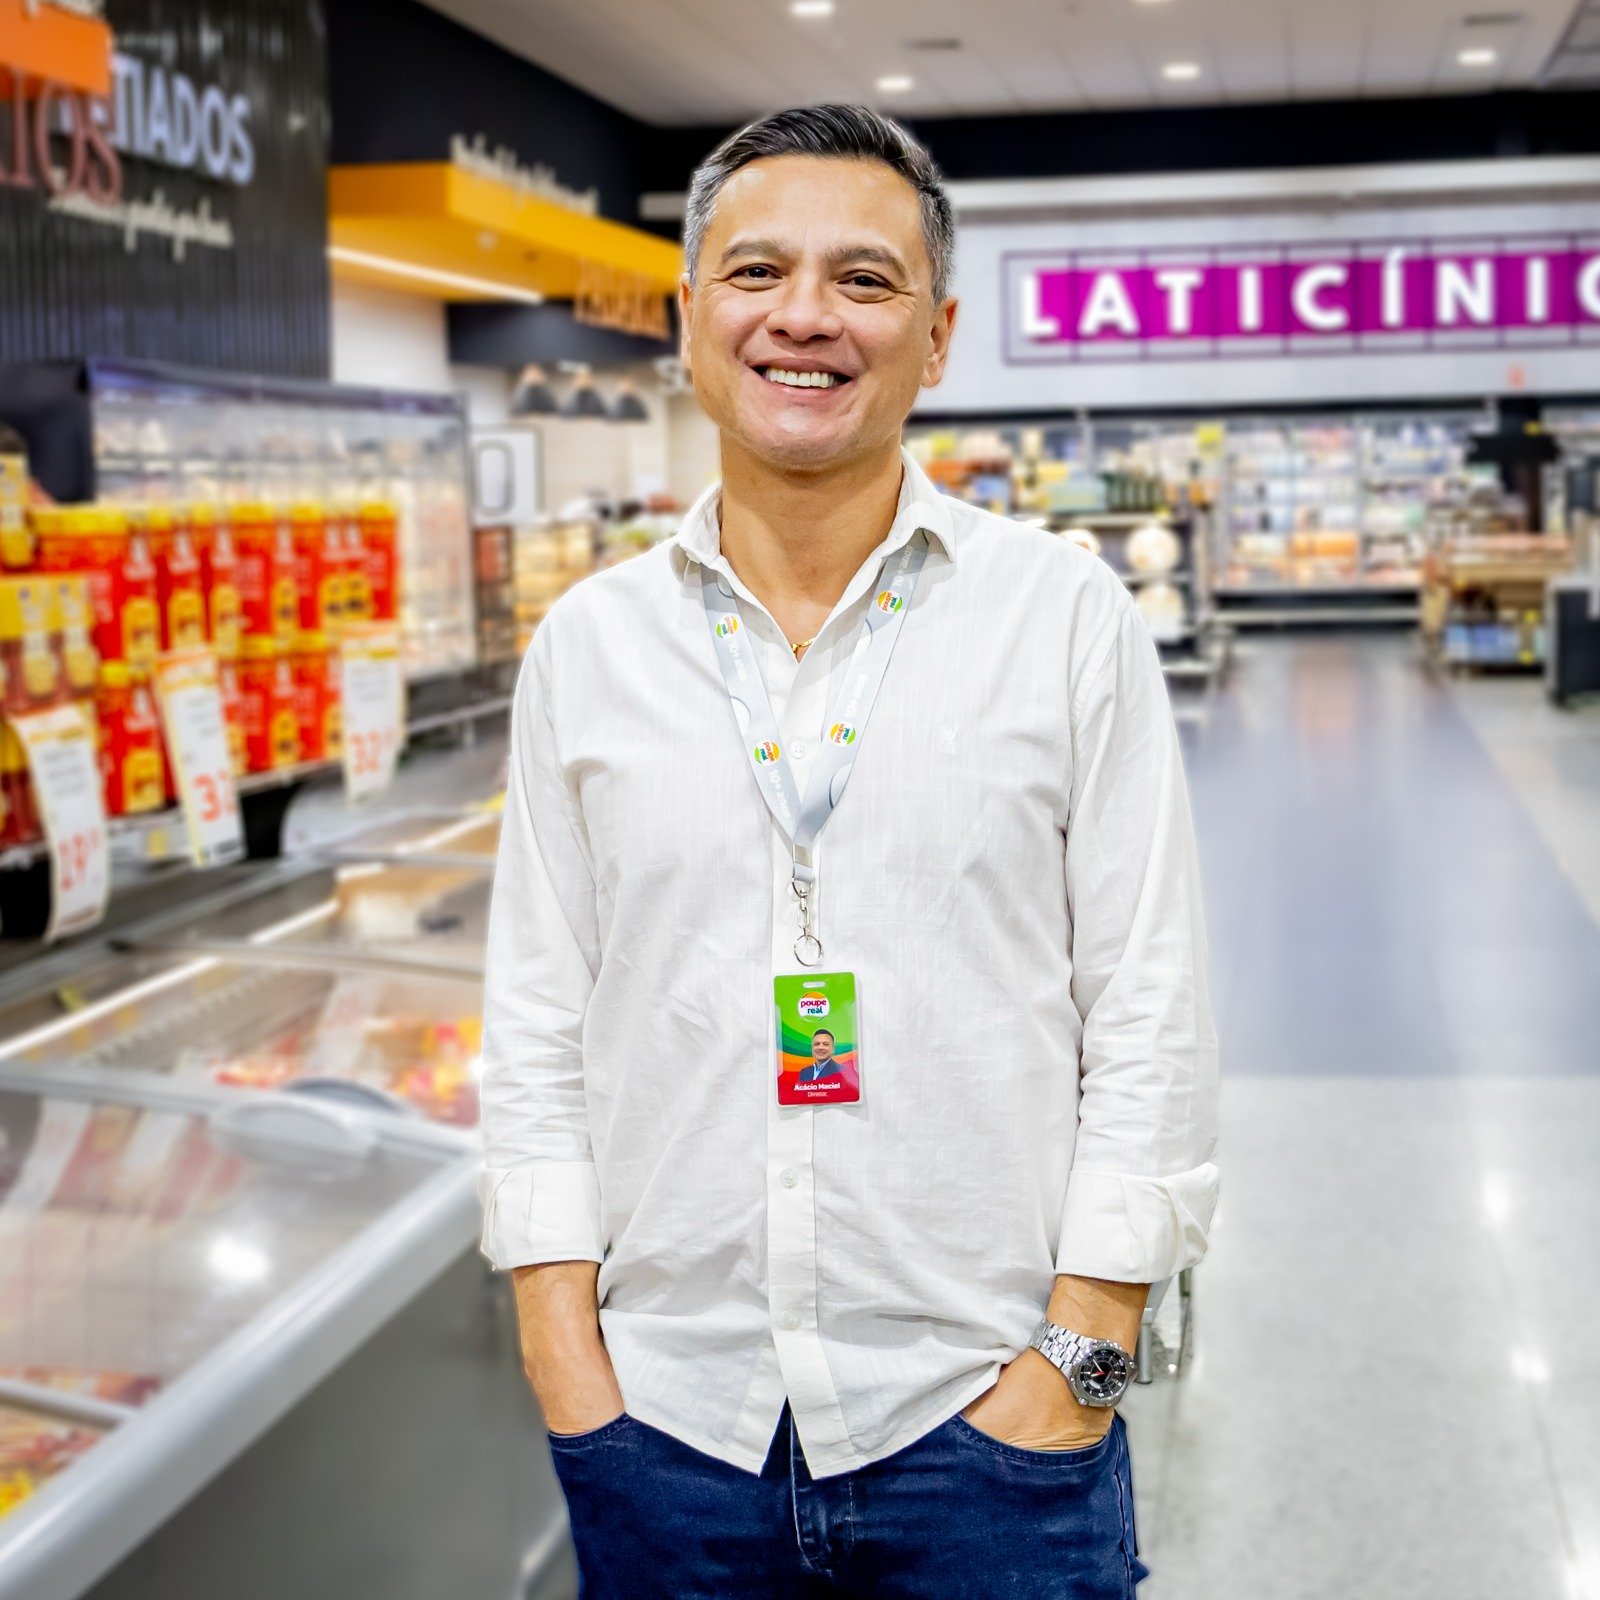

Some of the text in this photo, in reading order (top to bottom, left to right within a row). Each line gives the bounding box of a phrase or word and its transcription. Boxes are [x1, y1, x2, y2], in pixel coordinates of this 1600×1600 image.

[881, 591, 893, 612] poupe
[889, 596, 898, 609] real
[723, 616, 735, 636] poupe
[834, 723, 846, 744] poupe
[842, 727, 851, 741] real
[759, 748, 769, 762] real
[763, 741, 776, 763] poupe
[800, 1000, 827, 1009] poupe
[807, 1006, 823, 1015] real
